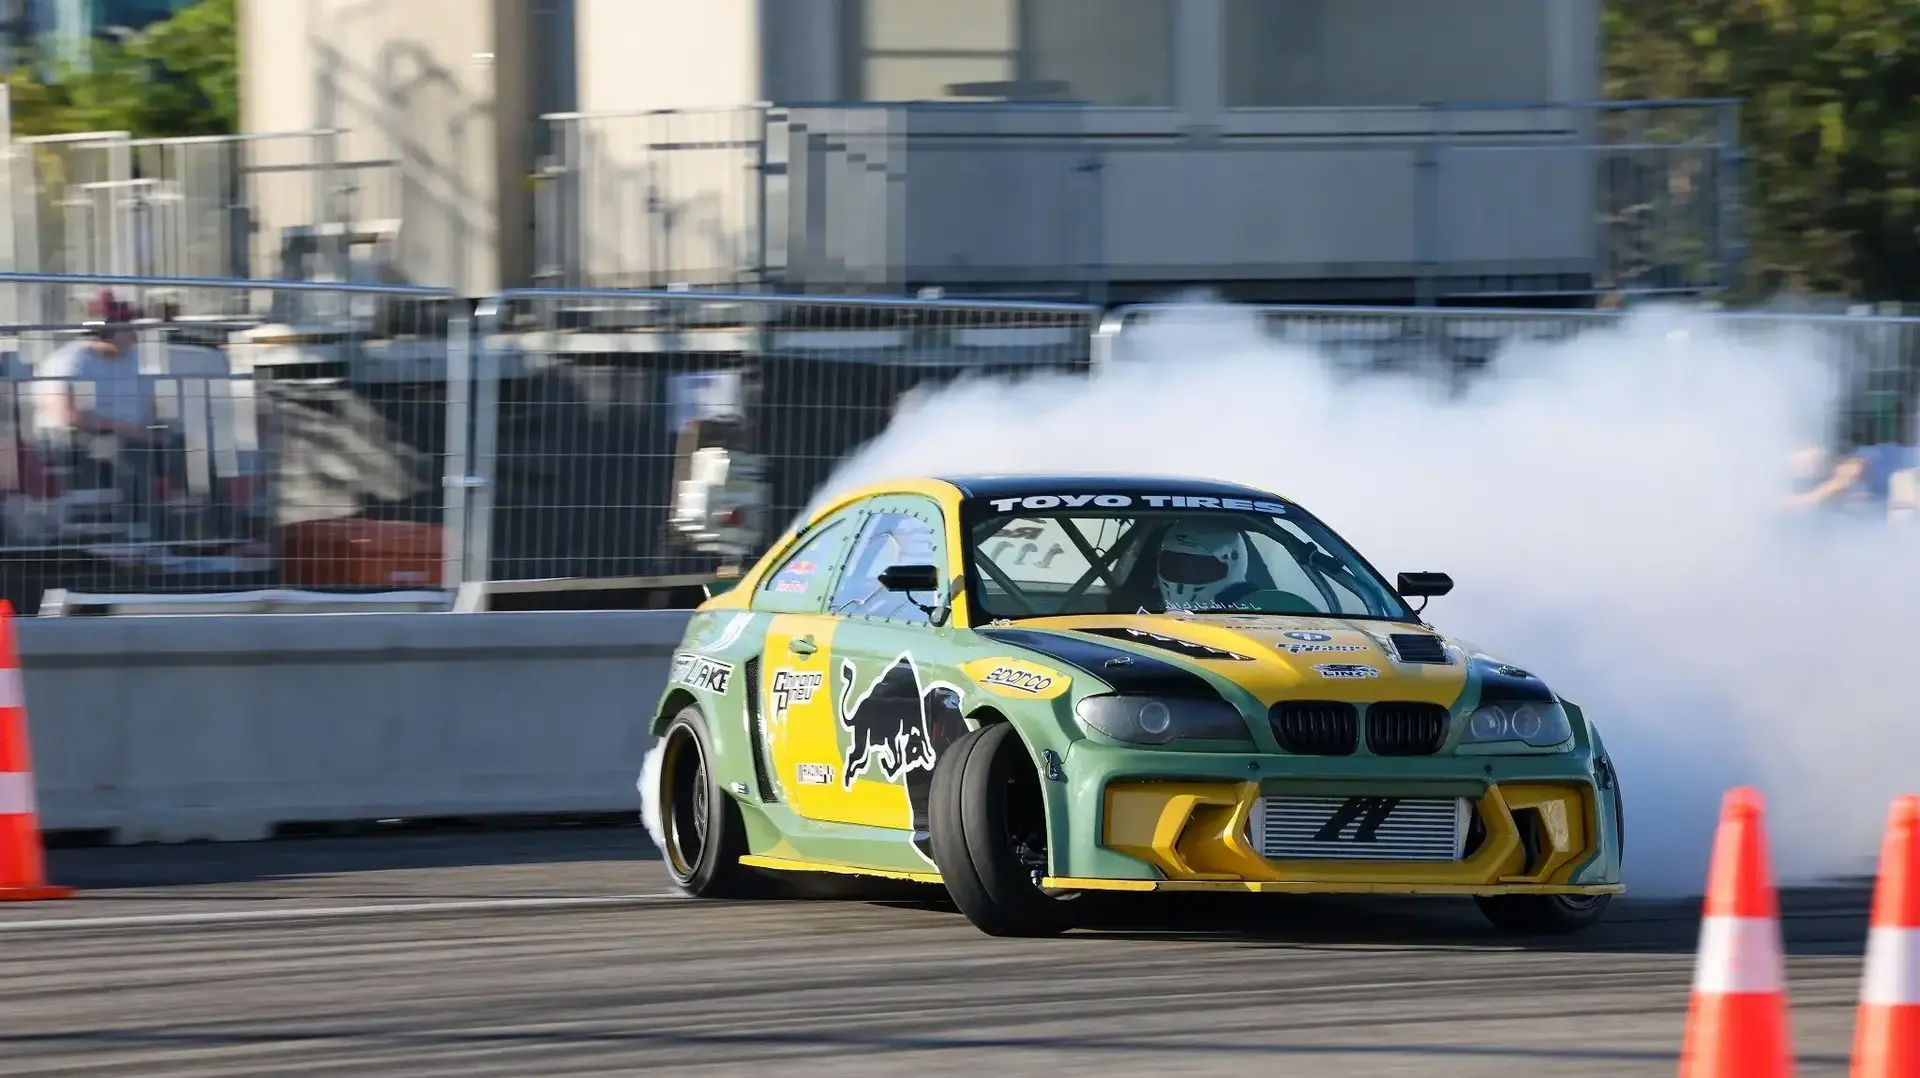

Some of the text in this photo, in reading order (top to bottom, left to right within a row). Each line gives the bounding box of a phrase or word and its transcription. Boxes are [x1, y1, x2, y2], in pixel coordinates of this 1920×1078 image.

[990, 494, 1286, 515] TOYO TIRES
[986, 667, 1052, 690] sparco
